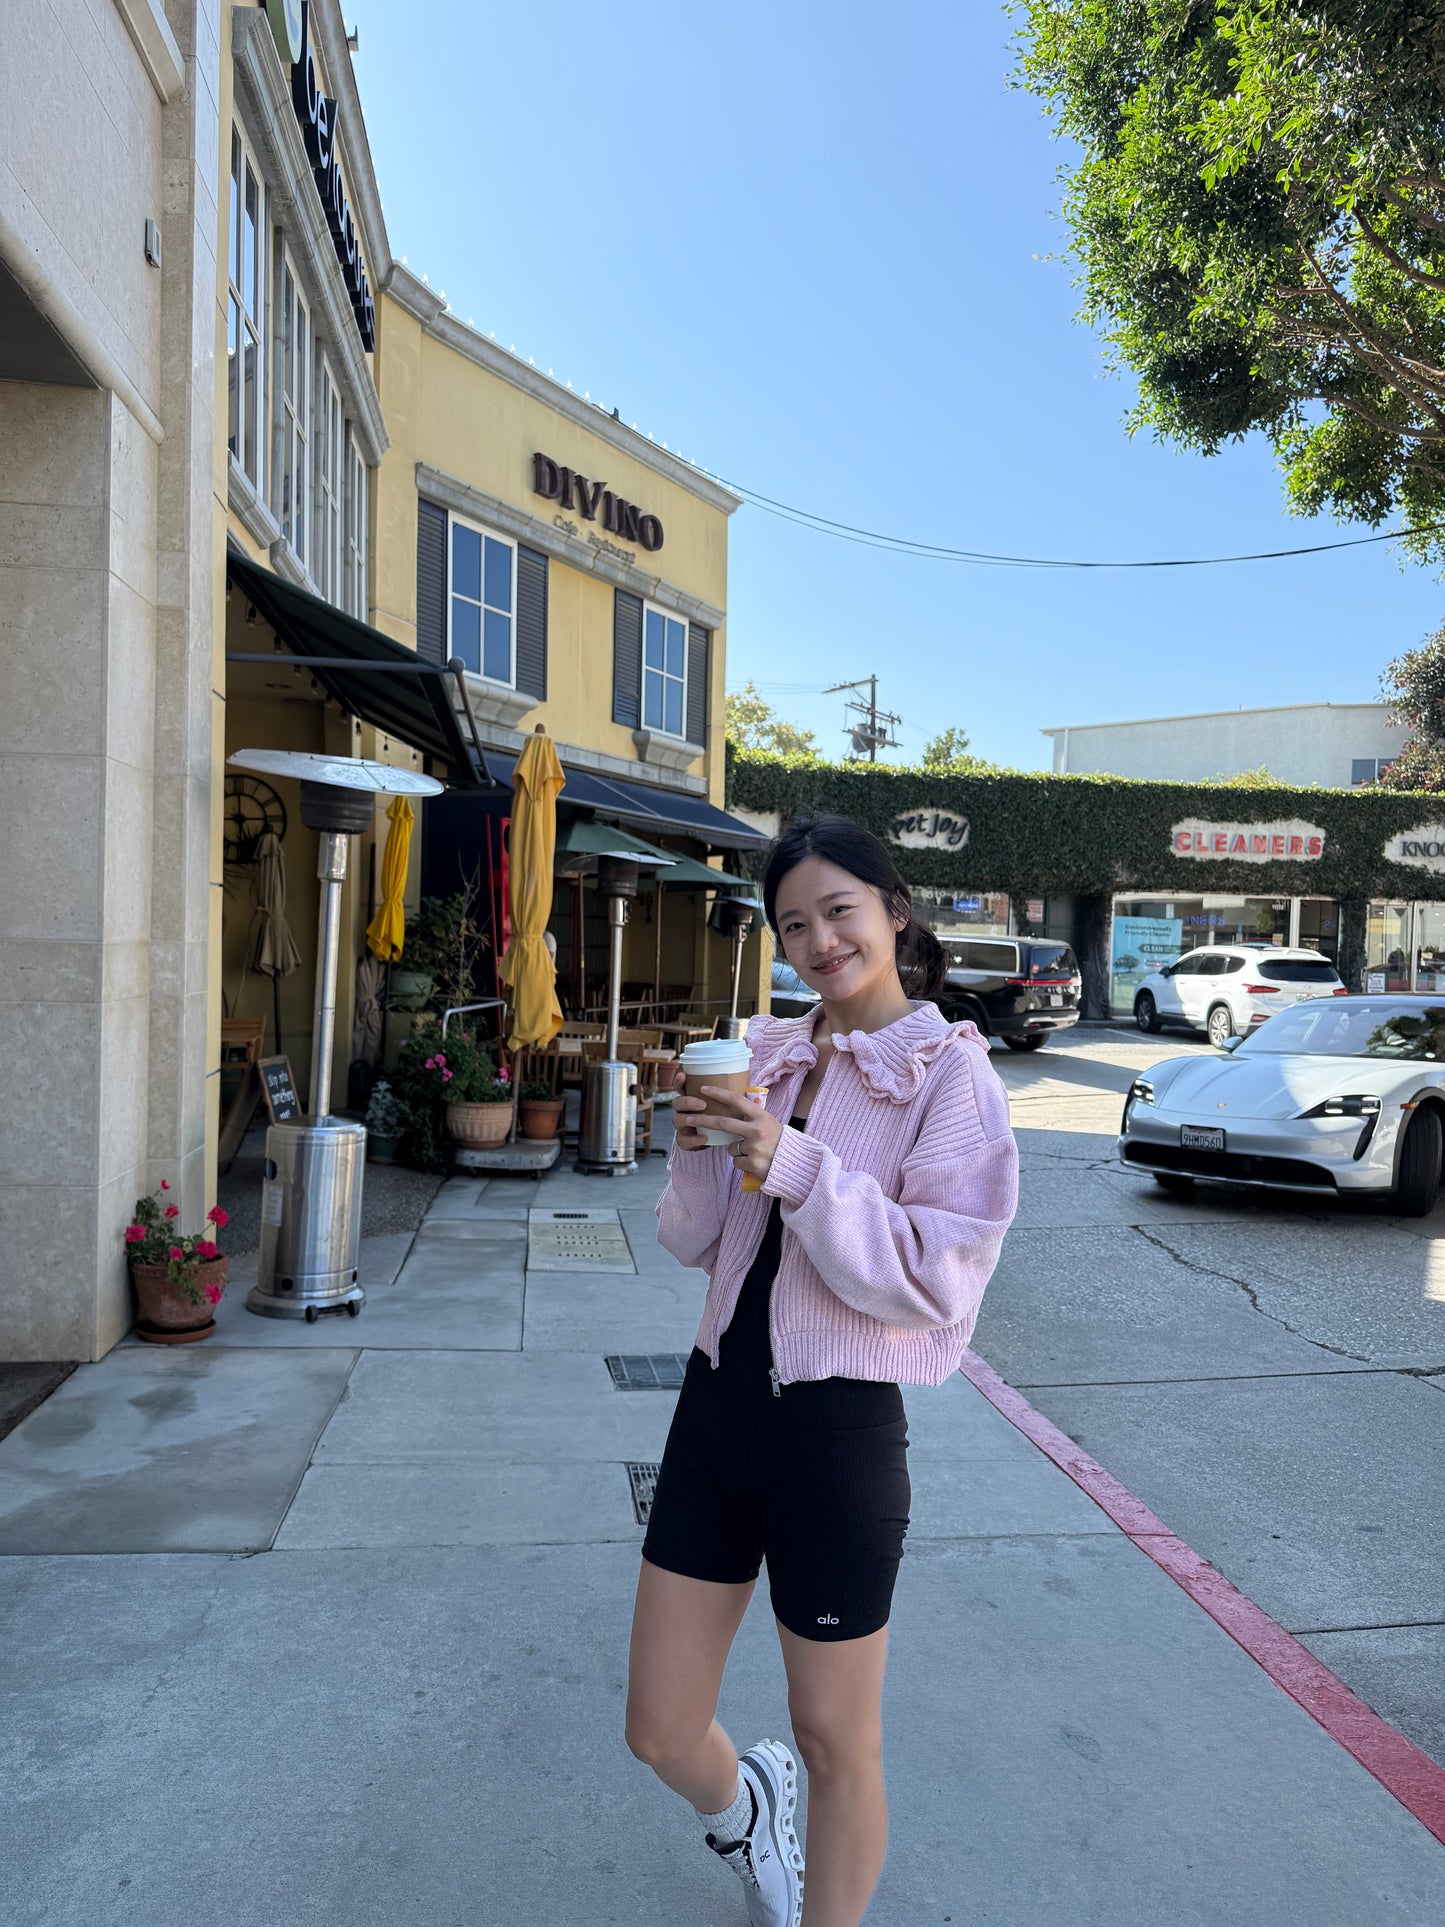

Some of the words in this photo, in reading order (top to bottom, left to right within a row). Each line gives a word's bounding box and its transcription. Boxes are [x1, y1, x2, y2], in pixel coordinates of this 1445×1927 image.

[533, 452, 664, 552] DIVINO
[1176, 832, 1322, 855] CLEANERS
[817, 1613, 840, 1625] alo
